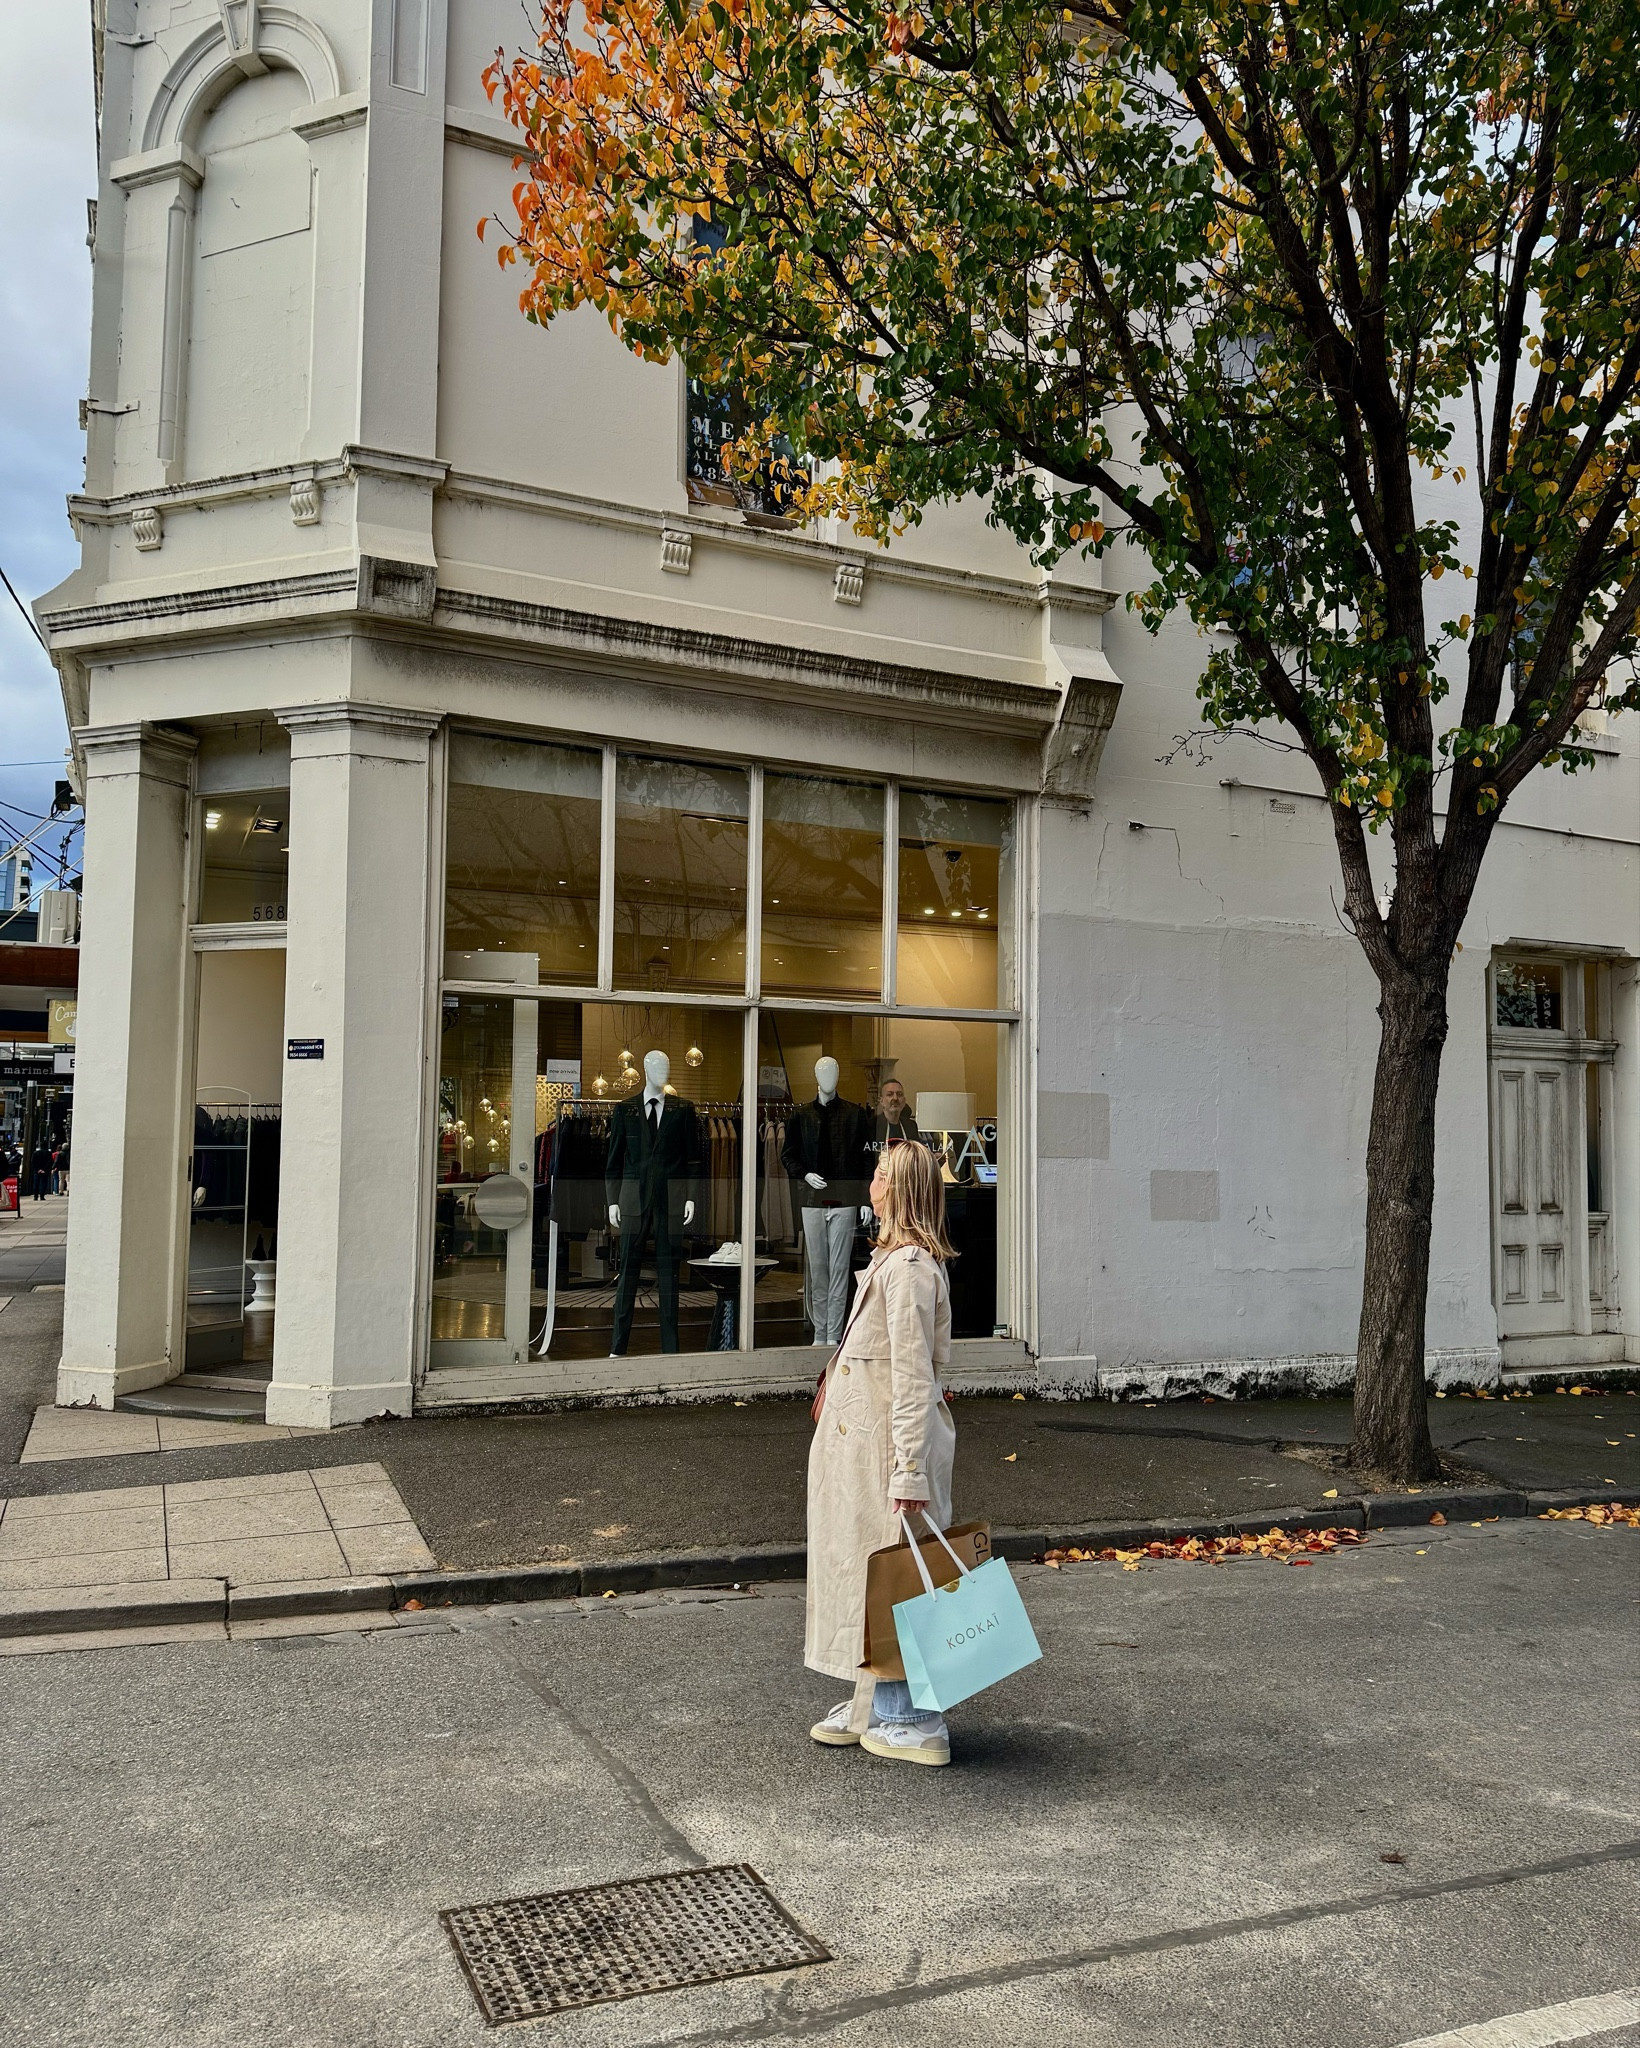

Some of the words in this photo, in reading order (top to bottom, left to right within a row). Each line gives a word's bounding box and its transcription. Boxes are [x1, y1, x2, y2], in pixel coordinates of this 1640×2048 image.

[253, 905, 285, 921] 568
[55, 1006, 77, 1022] Cam
[974, 1532, 988, 1565] GL
